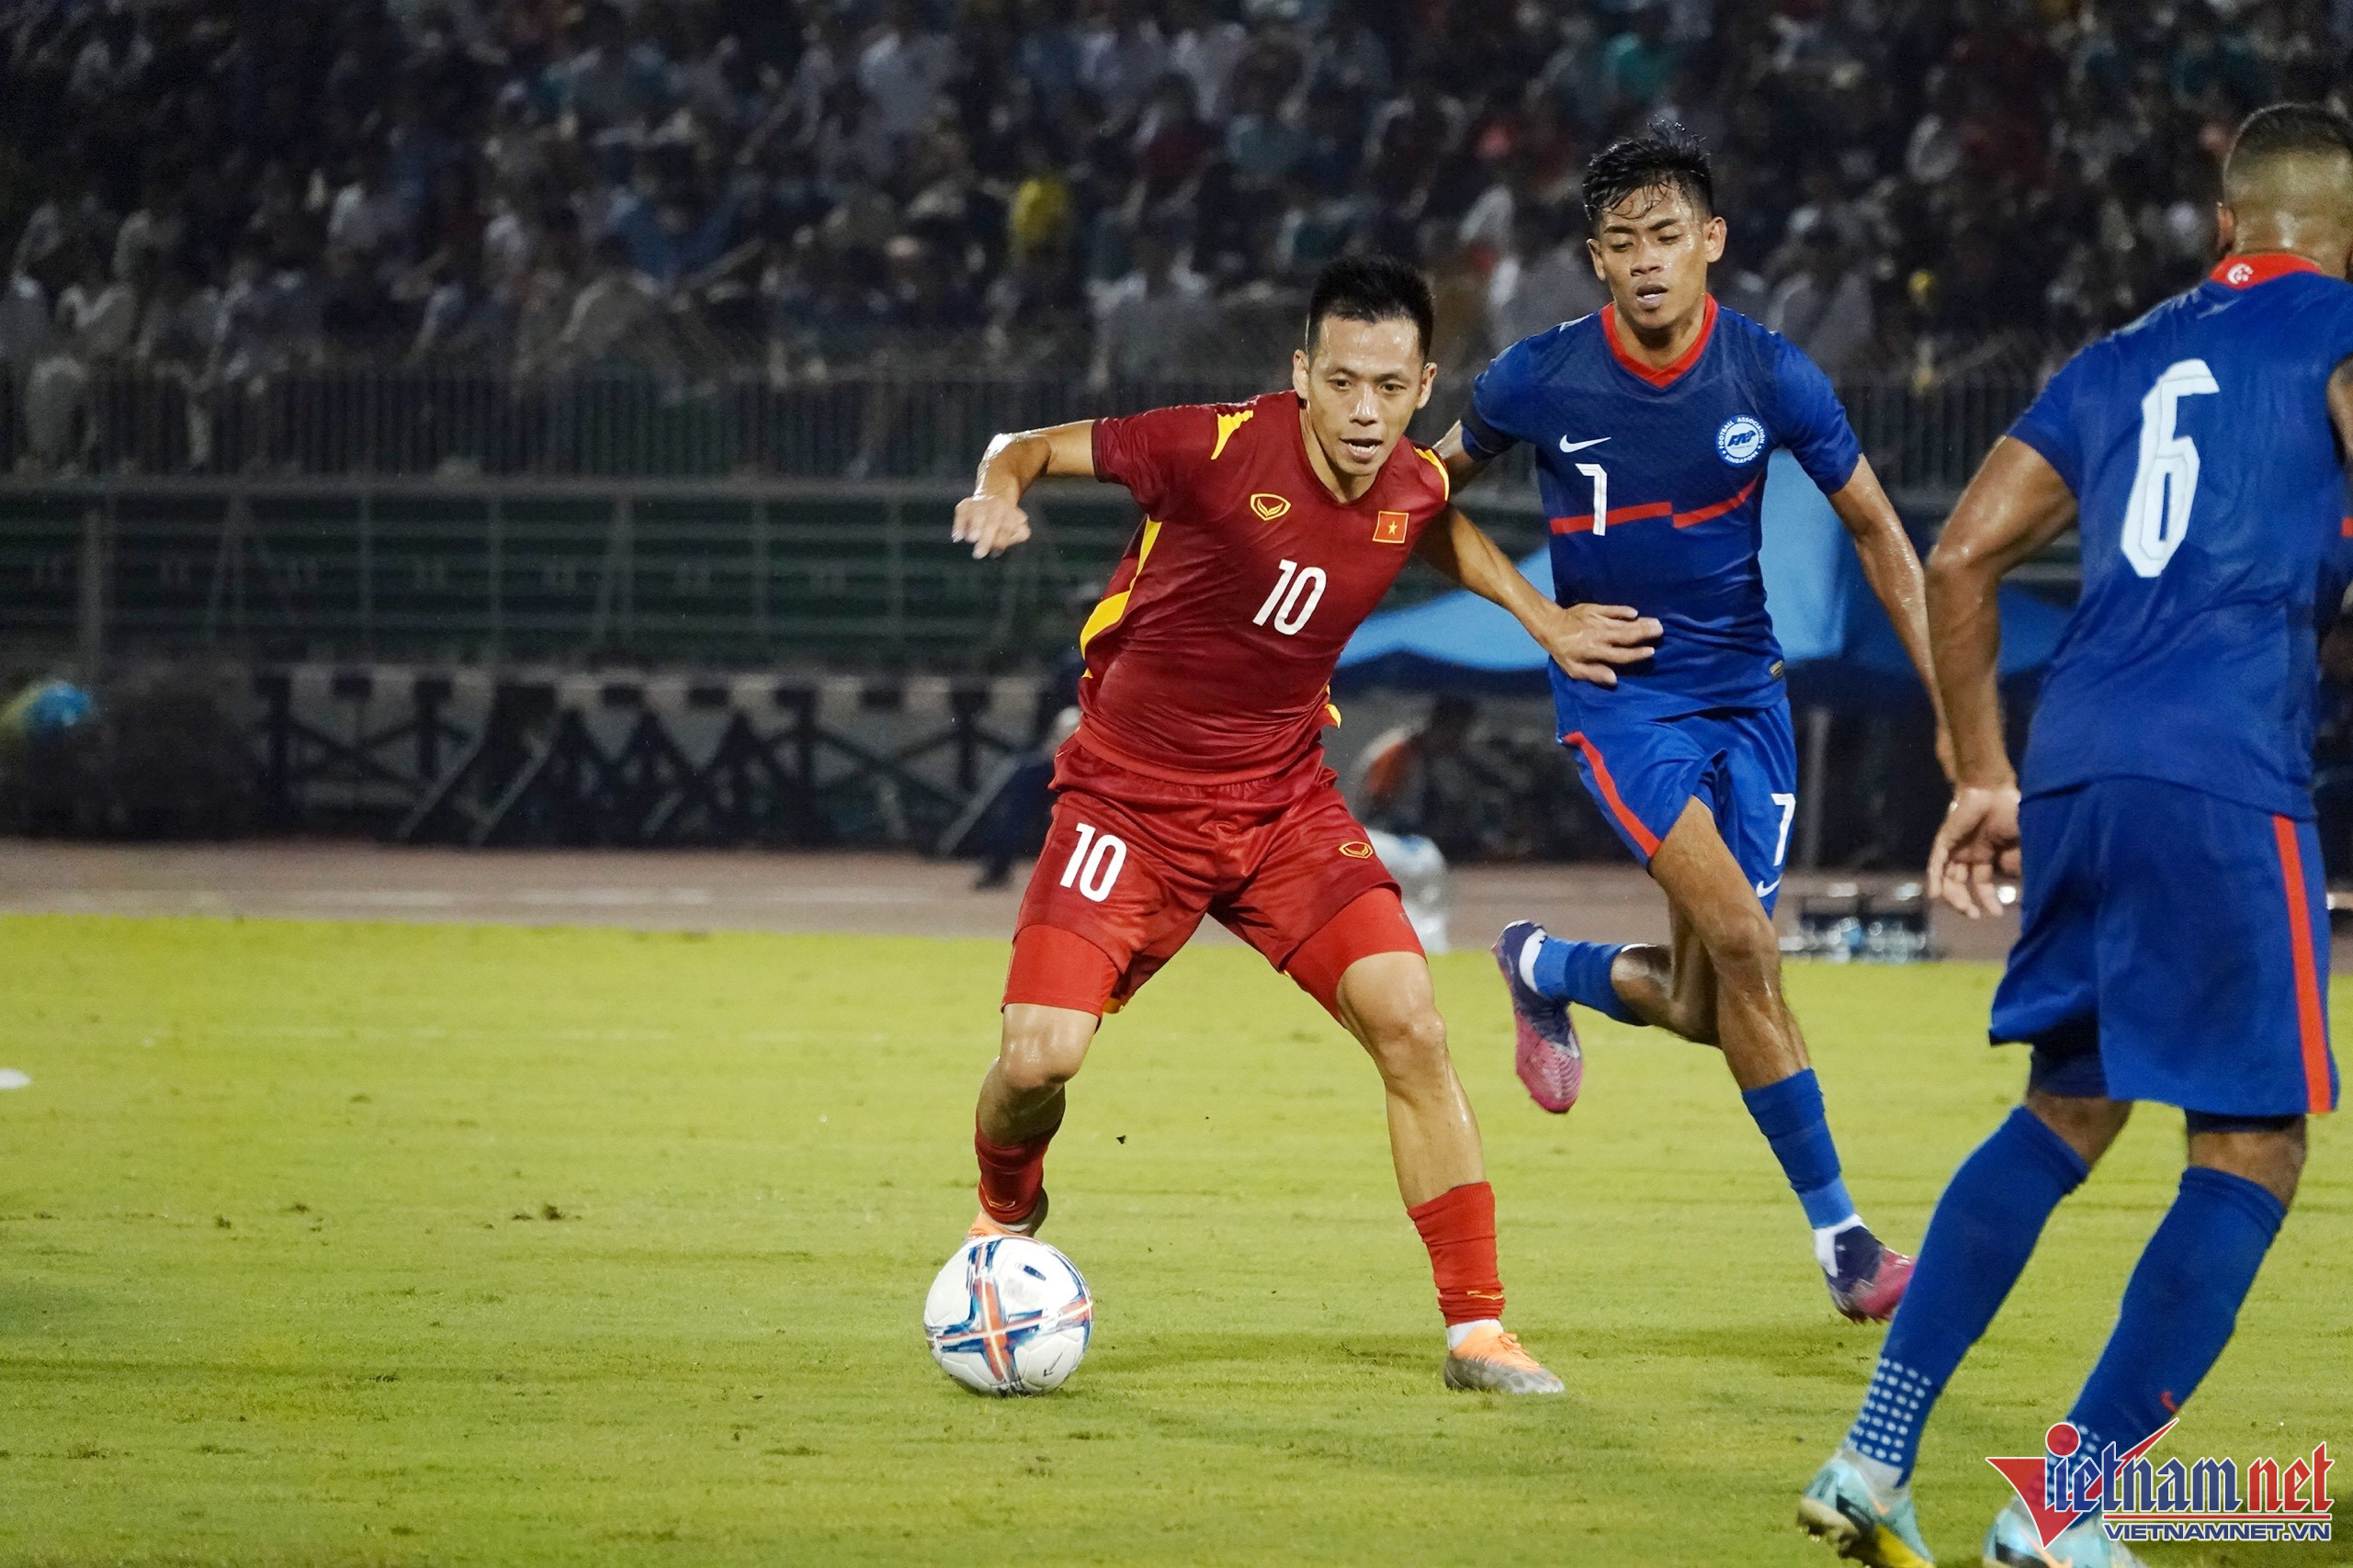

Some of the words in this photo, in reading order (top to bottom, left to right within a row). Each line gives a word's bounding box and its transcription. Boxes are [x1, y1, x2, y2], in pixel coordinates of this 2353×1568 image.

[1718, 420, 1735, 449] FOOTBALL
[1736, 416, 1765, 444] ASSOCIATION
[1725, 450, 1759, 464] SINGAPORE
[2121, 357, 2221, 579] 6
[1575, 463, 1608, 536] 7
[1252, 558, 1327, 636] 10
[1059, 823, 1127, 903] 10
[1770, 793, 1796, 866] 7
